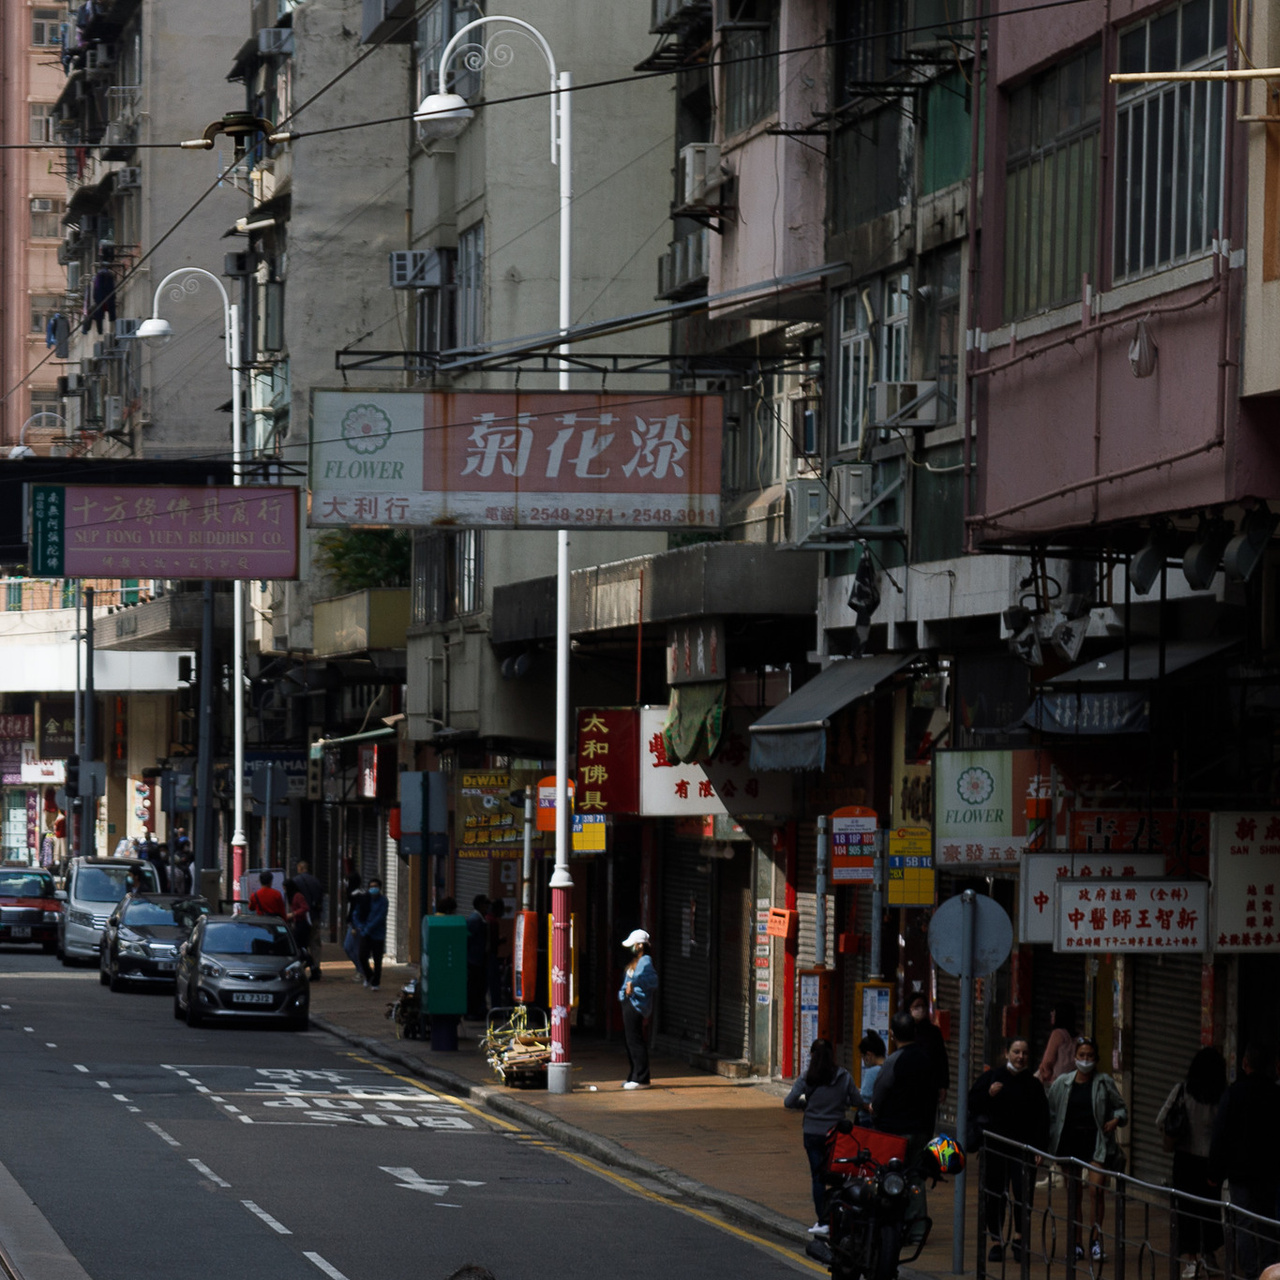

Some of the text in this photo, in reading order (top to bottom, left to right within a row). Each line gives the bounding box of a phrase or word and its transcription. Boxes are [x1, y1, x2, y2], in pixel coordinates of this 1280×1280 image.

[460, 412, 696, 479] 菊花漆
[324, 460, 404, 480] FLOWER
[322, 496, 410, 520] 大利行
[530, 507, 569, 521] 2548
[575, 508, 614, 522] 2971
[632, 508, 671, 522] 2548
[677, 508, 716, 523] 3011
[75, 530, 285, 545] SUP FONG YUEN BUDDHIST CO.
[579, 713, 610, 810] 太和佛具
[675, 779, 760, 799] 有限公司
[945, 809, 1004, 824] FLOWER
[835, 834, 846, 844] 18
[848, 834, 861, 844] 18P
[834, 846, 847, 856] 104
[1230, 845, 1249, 855] SAN
[906, 857, 919, 866] 5B
[1034, 891, 1049, 913] 中
[1079, 888, 1188, 902] 政府註冊 (全科)
[1068, 907, 1198, 931] 中醫師王智新
[263, 1096, 471, 1114] STOP
[303, 1110, 476, 1129] BUS
